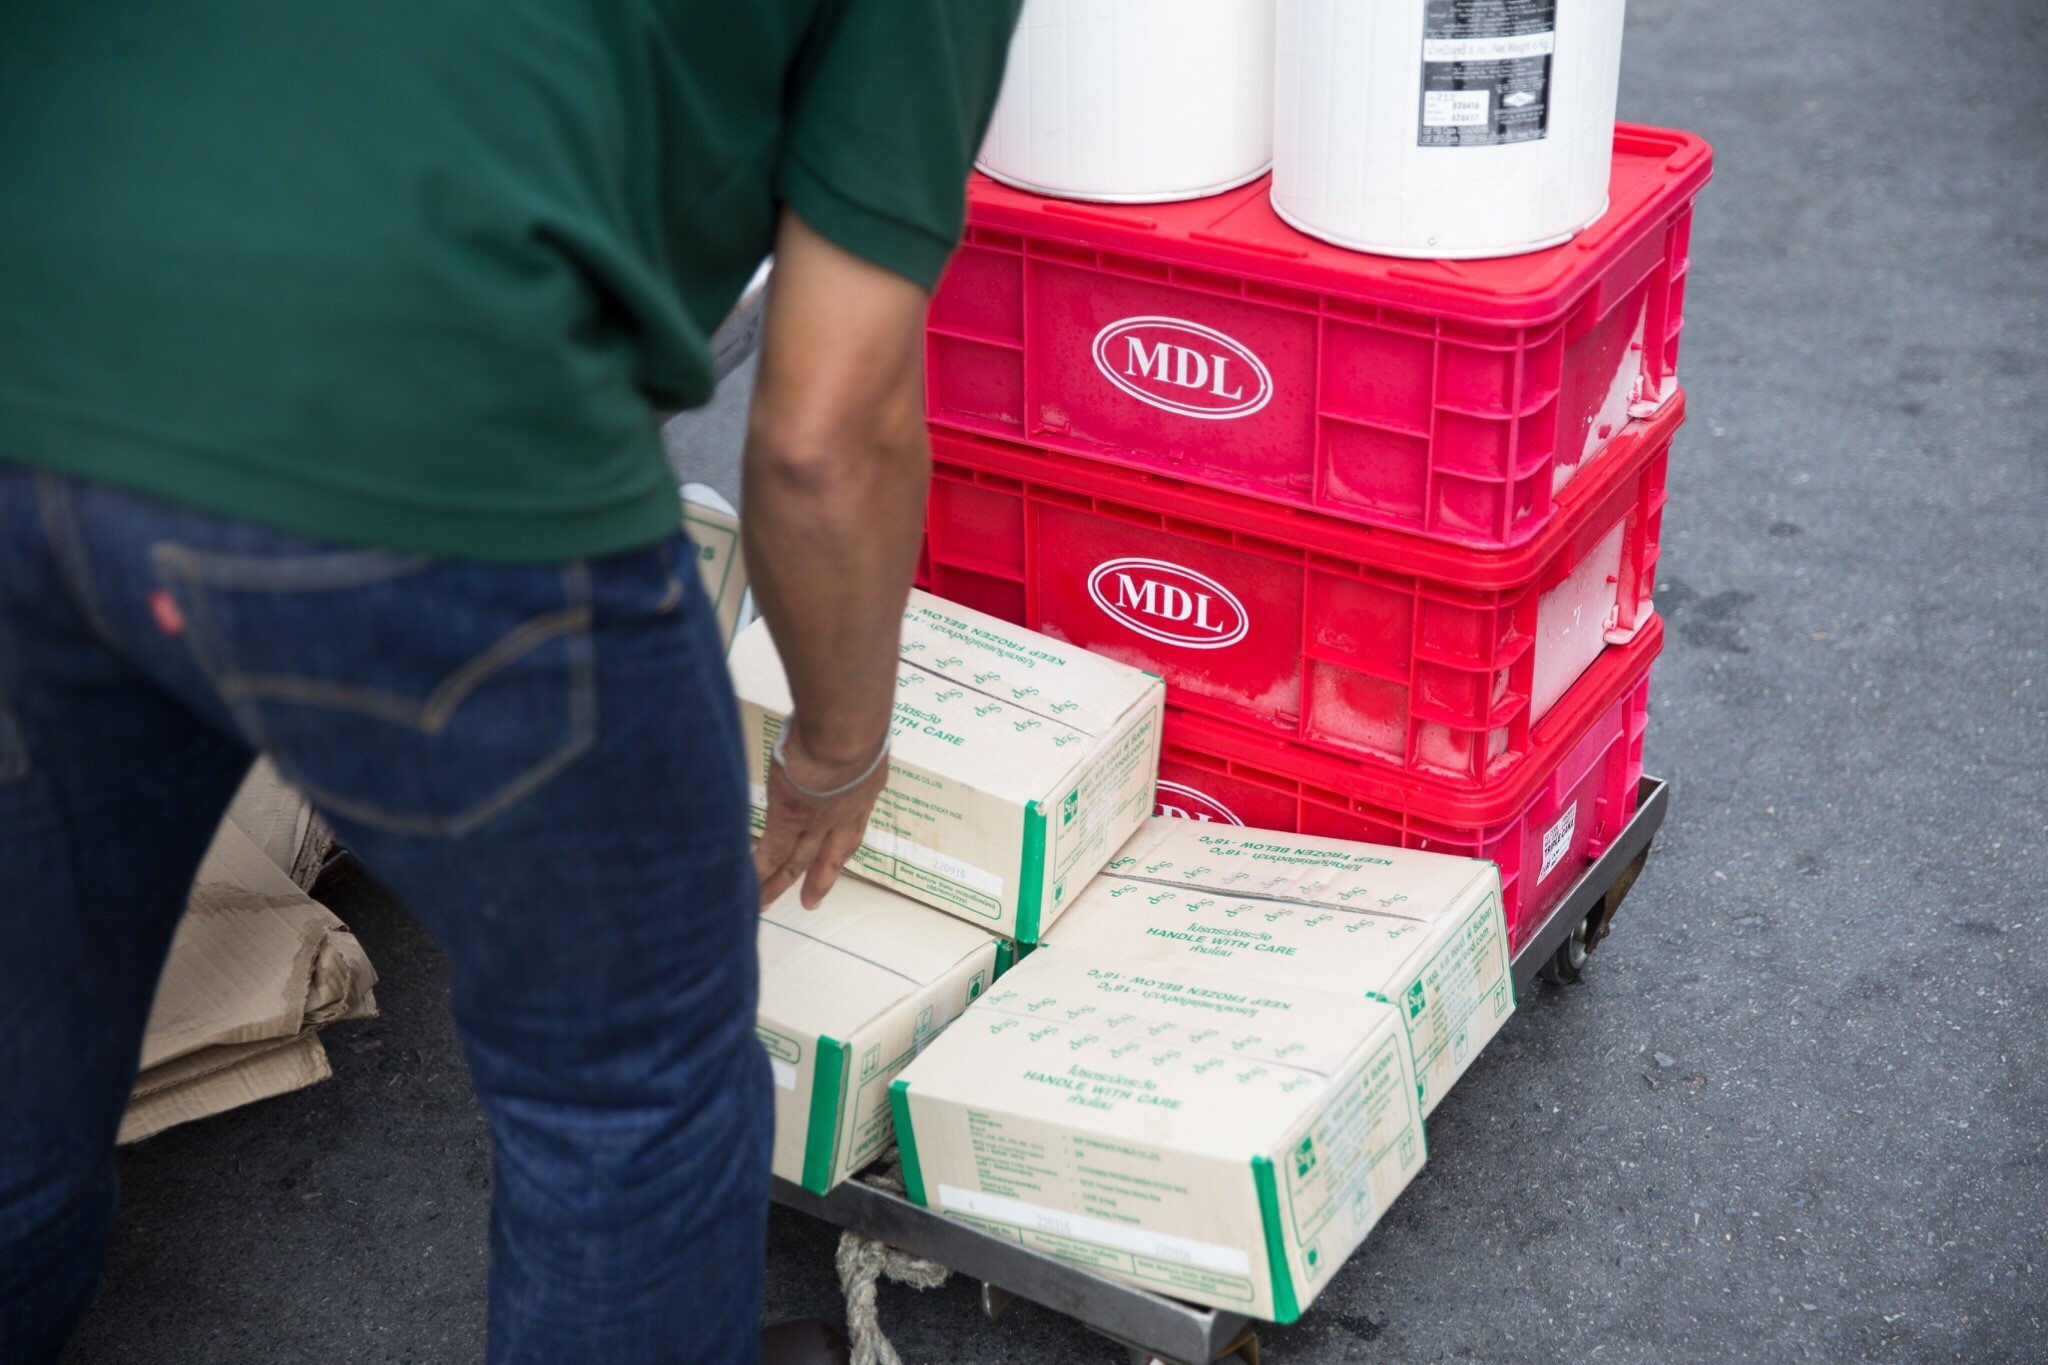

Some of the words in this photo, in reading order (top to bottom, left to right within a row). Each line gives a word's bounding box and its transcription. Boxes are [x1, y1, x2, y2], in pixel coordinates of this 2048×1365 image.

[1124, 335, 1243, 400] MDL
[1115, 572, 1224, 633] MDL
[920, 608, 968, 630] BELOW
[971, 628, 1026, 651] FROZEN
[1029, 650, 1067, 666] KEEP
[923, 727, 966, 746] CARE
[1240, 842, 1291, 854] BELOW
[1294, 848, 1352, 860] FROZEN
[1354, 856, 1394, 866] KEEP
[1146, 928, 1208, 943] HANDLE
[1212, 938, 1250, 949] WITH
[1255, 943, 1297, 956] CARE
[1130, 976, 1183, 992] BELOW
[1187, 987, 1247, 1003] FROZEN
[1250, 998, 1292, 1010] KEEP
[1023, 1070, 1088, 1092] HANDLE
[1092, 1085, 1133, 1099] WITH
[1136, 1094, 1182, 1110] CARE
